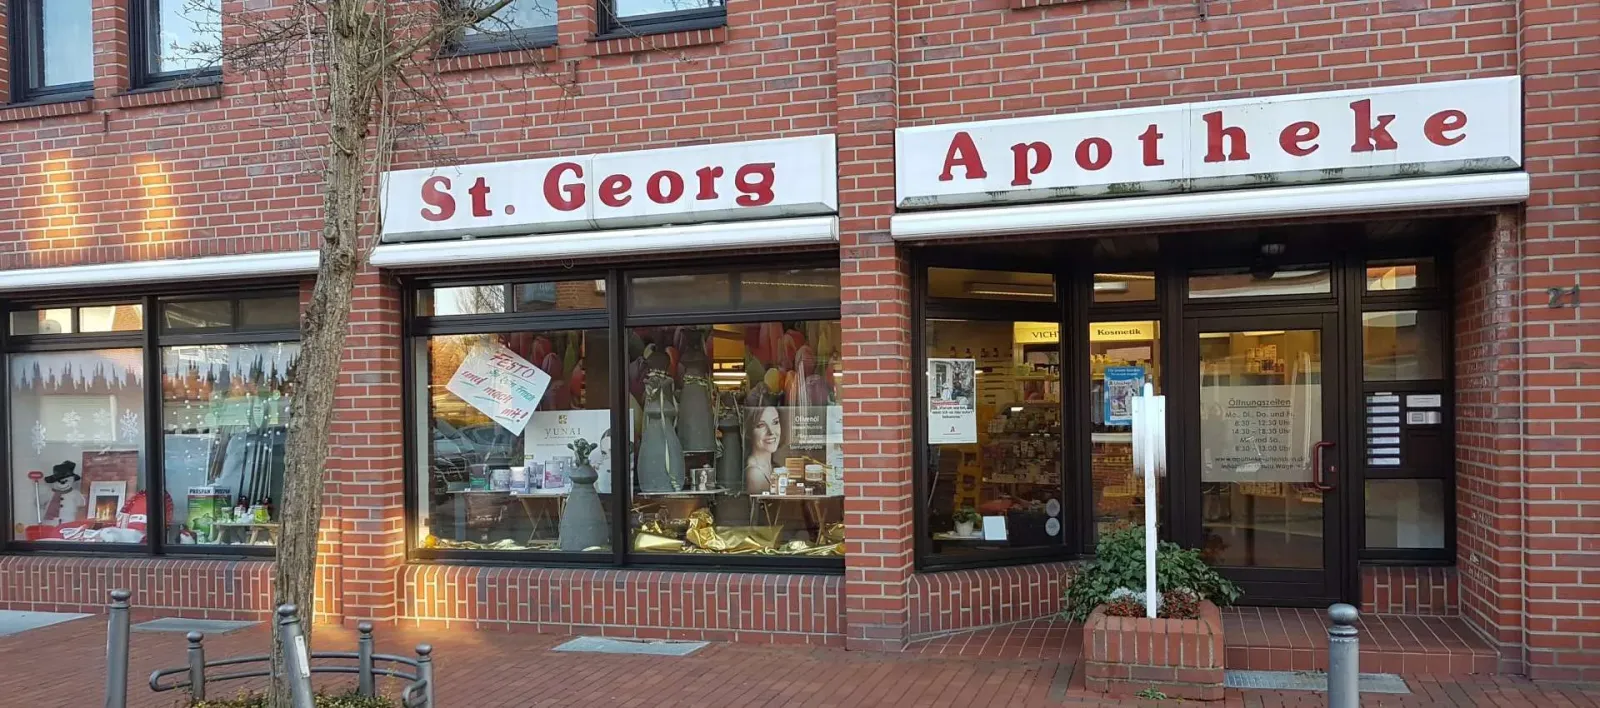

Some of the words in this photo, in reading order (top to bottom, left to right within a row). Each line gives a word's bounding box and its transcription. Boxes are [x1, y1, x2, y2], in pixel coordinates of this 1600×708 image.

[937, 98, 1469, 186] Apotheke
[420, 175, 516, 222] St.
[542, 161, 777, 212] Georg
[1547, 284, 1581, 308] 21
[1097, 328, 1142, 336] Kosmetik
[461, 370, 488, 385] und
[1228, 397, 1291, 407] Öffnungszeiten
